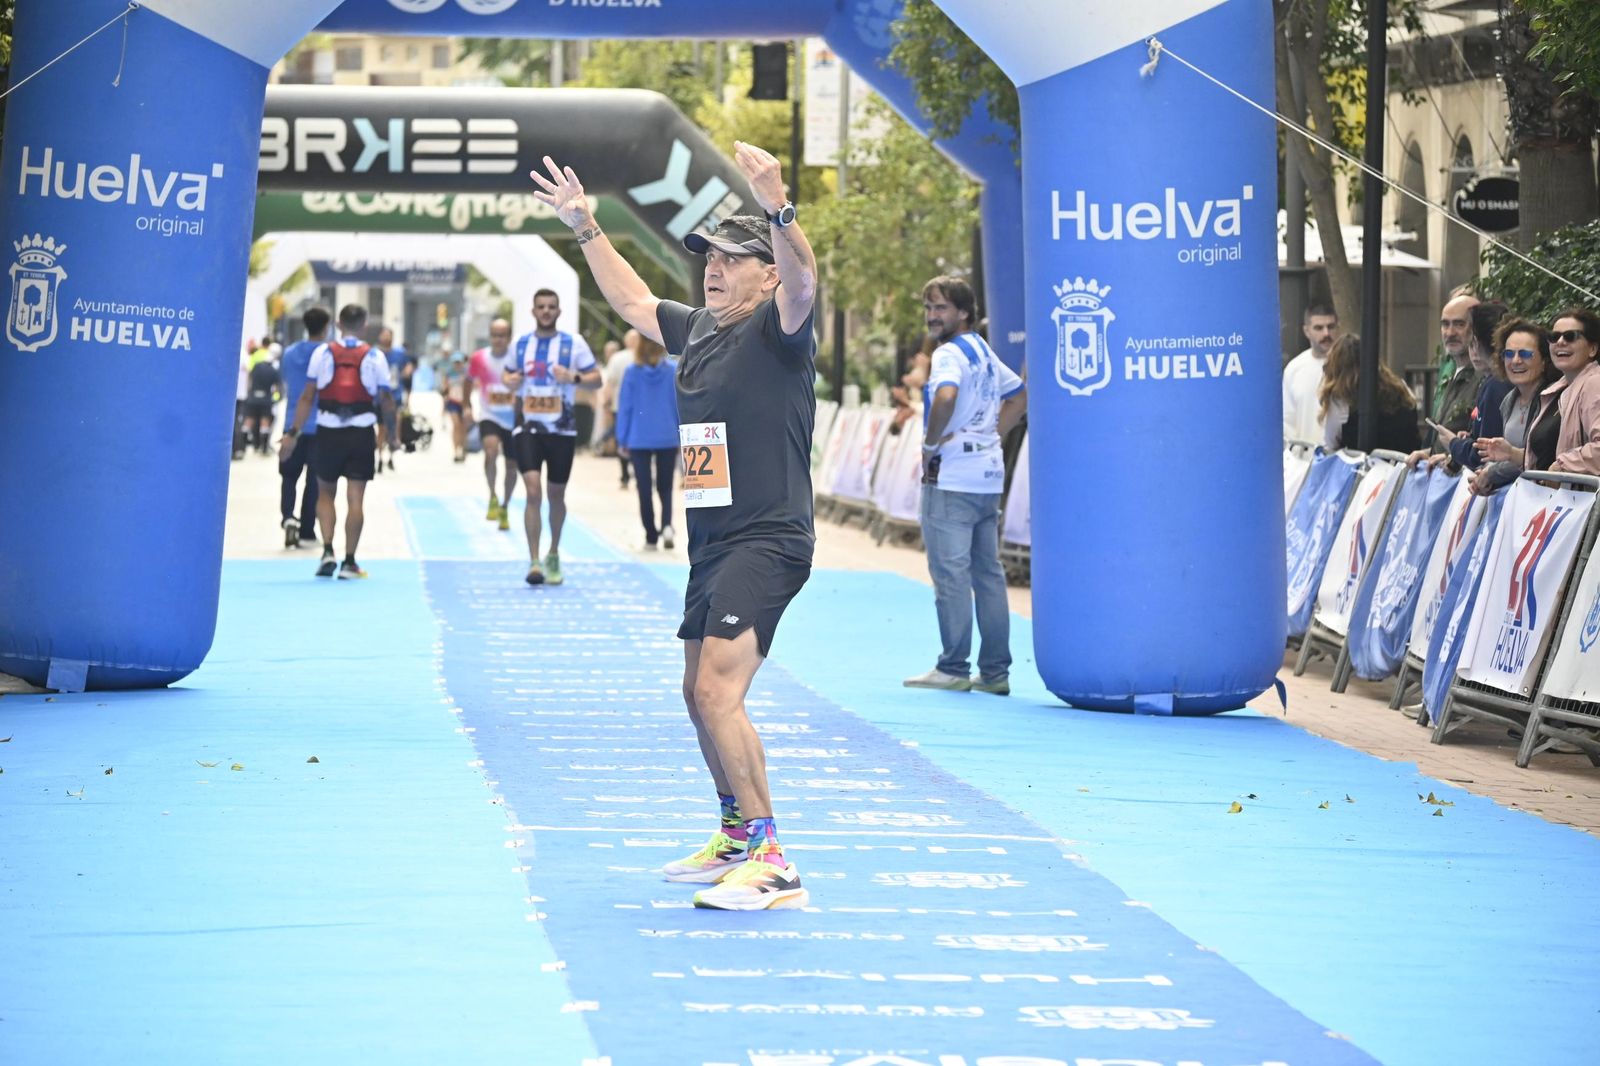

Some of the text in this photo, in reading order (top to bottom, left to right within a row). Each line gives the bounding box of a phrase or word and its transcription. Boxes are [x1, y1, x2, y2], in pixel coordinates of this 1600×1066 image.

[18, 146, 208, 211] Huelva
[135, 214, 204, 237] original
[1051, 187, 1241, 240] Huelva
[1177, 242, 1242, 266] original
[73, 297, 195, 321] Ayuntamiento de
[70, 317, 191, 351] HUELVA
[1125, 332, 1243, 353] Ayuntamiento de
[1125, 352, 1243, 380] HUELVA
